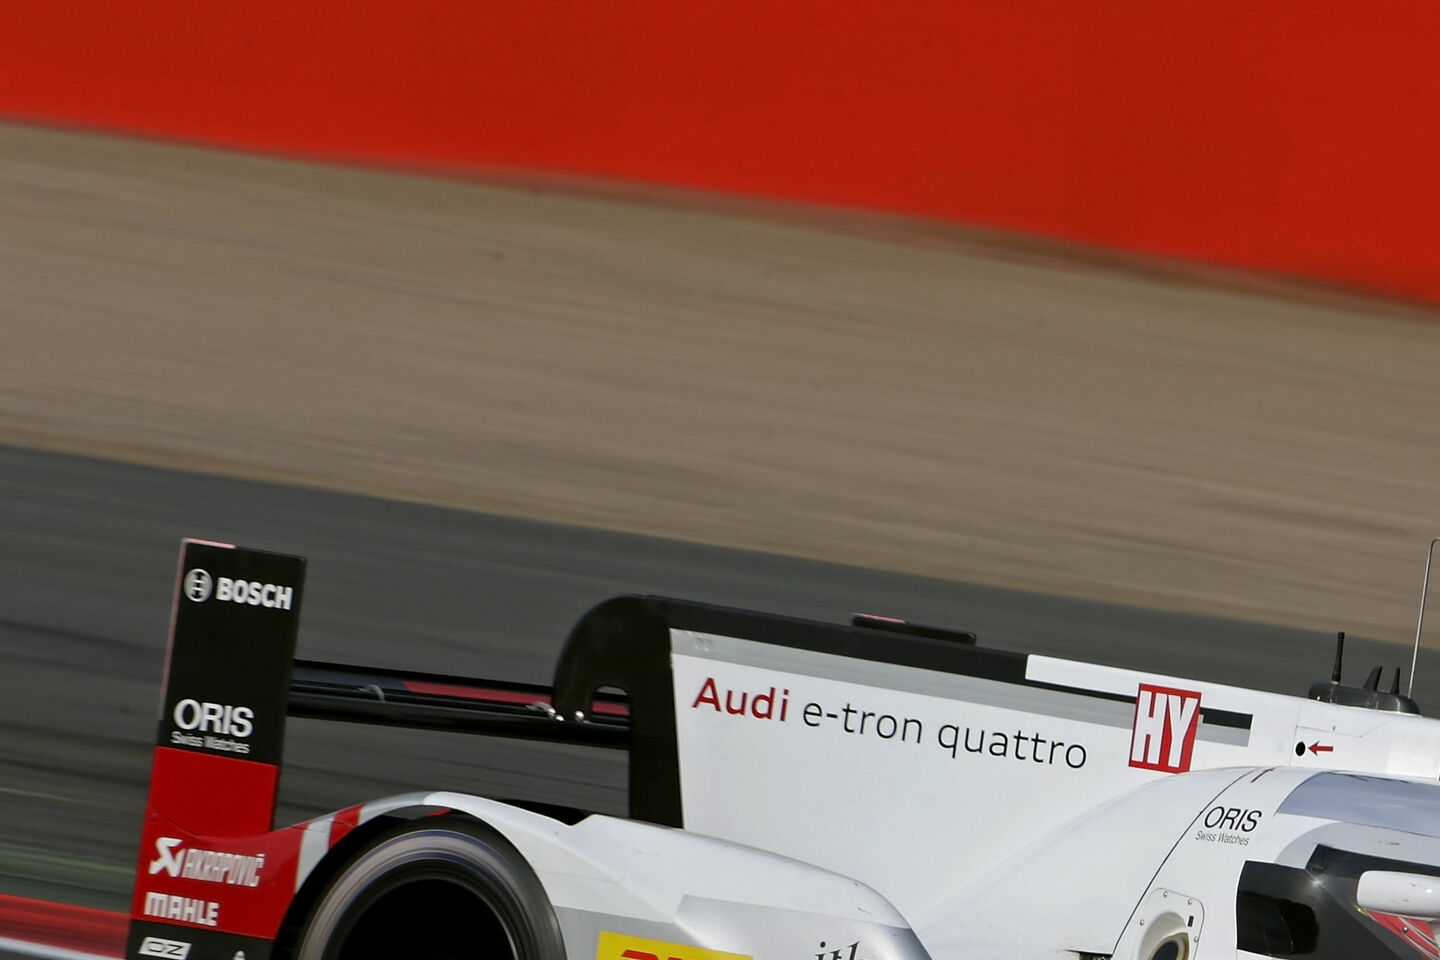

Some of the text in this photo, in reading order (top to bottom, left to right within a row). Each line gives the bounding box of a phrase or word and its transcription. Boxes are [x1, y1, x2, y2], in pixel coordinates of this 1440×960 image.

[216, 577, 293, 611] BOSCH
[173, 699, 254, 738] ORIS
[692, 677, 1088, 769] Audi e-tron quattro
[1133, 689, 1200, 768] HY
[170, 730, 251, 754] Swiss Watches
[1204, 806, 1262, 832] ORIS
[1195, 830, 1250, 846] Swiss Watches
[144, 891, 220, 927] MAHLE
